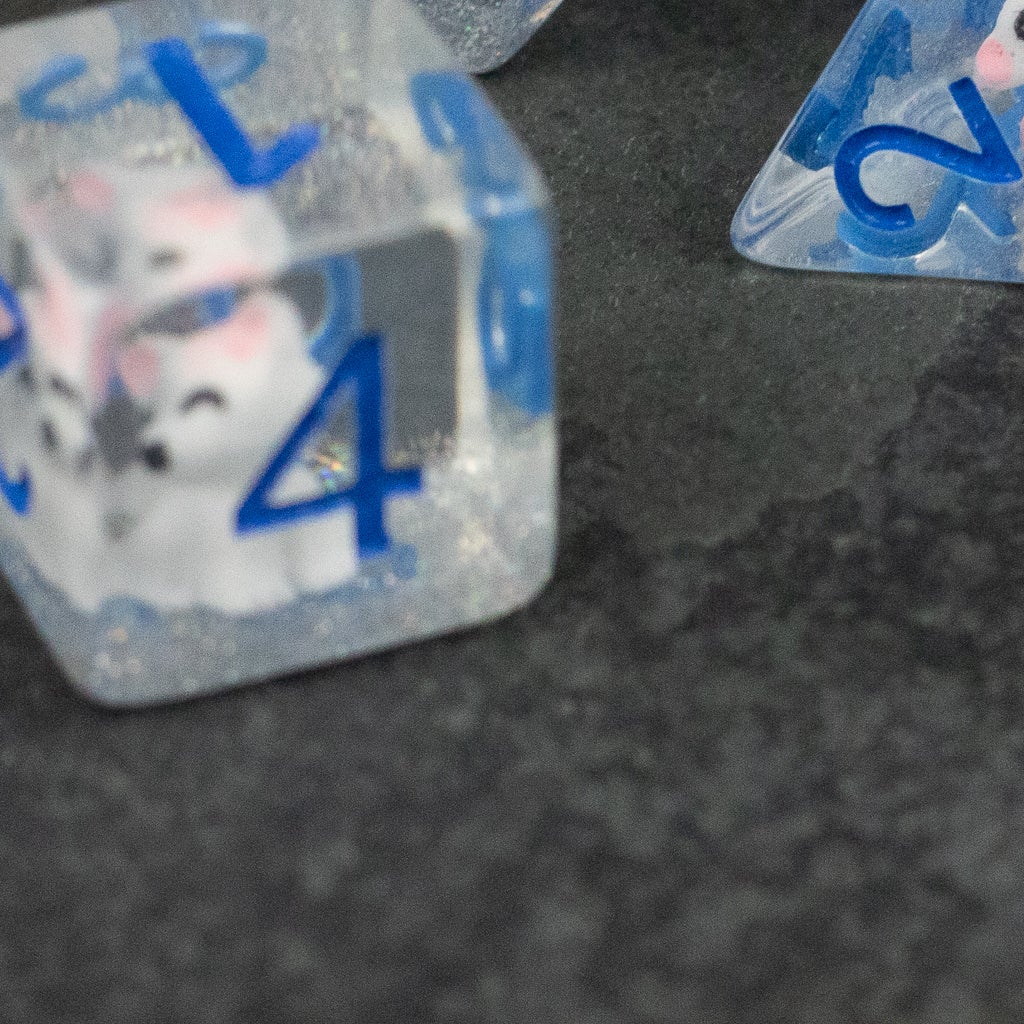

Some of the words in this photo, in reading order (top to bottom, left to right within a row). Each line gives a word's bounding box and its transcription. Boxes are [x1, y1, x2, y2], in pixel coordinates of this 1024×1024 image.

[143, 34, 322, 190] 1
[833, 76, 1023, 230] 2
[235, 332, 424, 560] 4
